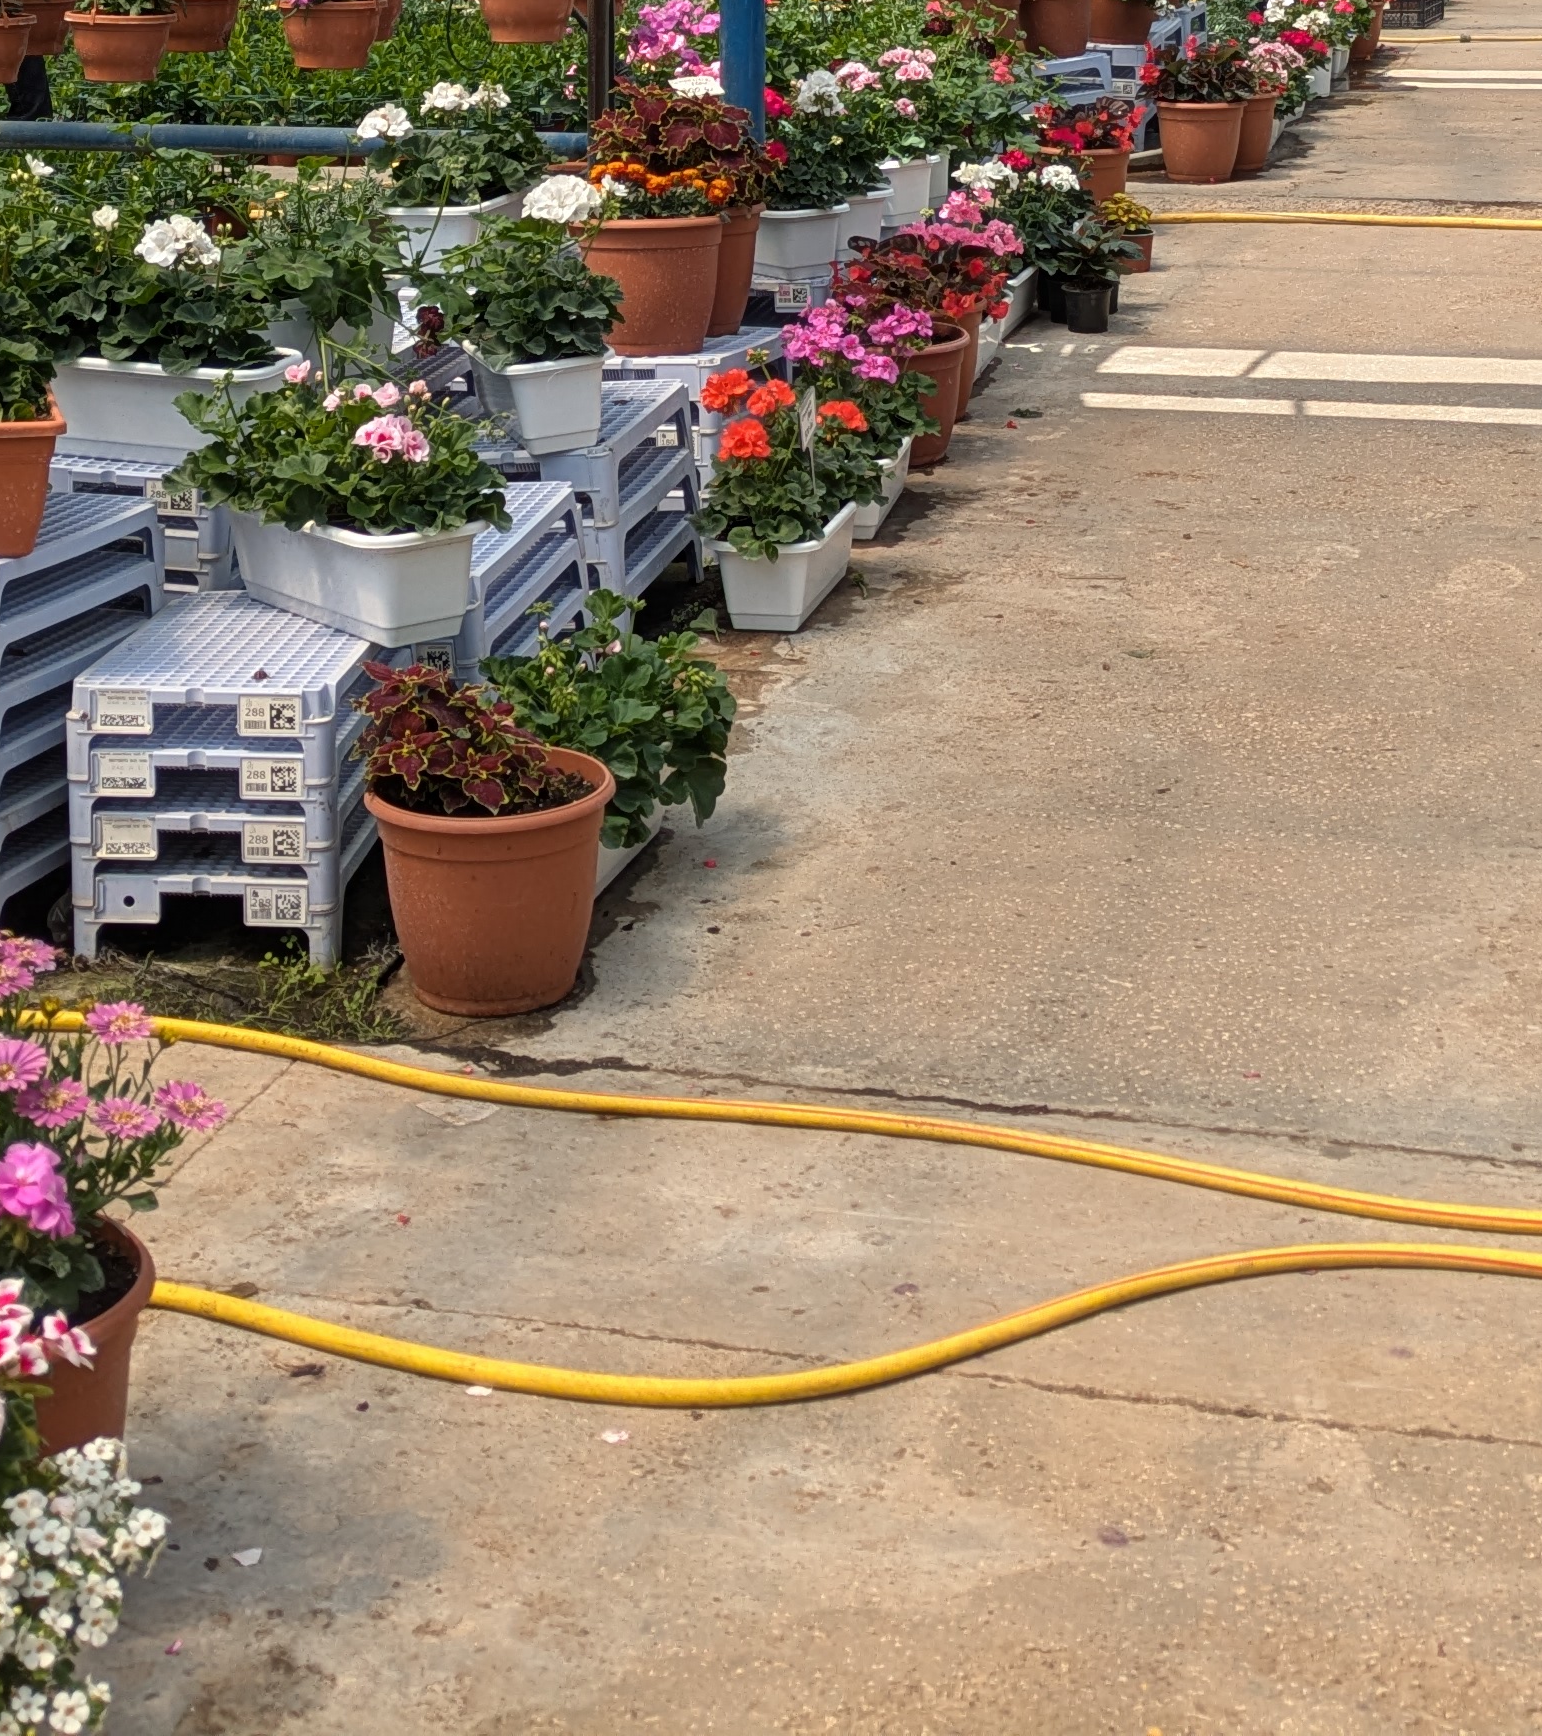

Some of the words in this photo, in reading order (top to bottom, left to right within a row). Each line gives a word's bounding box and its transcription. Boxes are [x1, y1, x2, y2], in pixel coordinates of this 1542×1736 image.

[244, 707, 265, 717] 288
[246, 770, 266, 779] 288
[248, 835, 269, 844] 288
